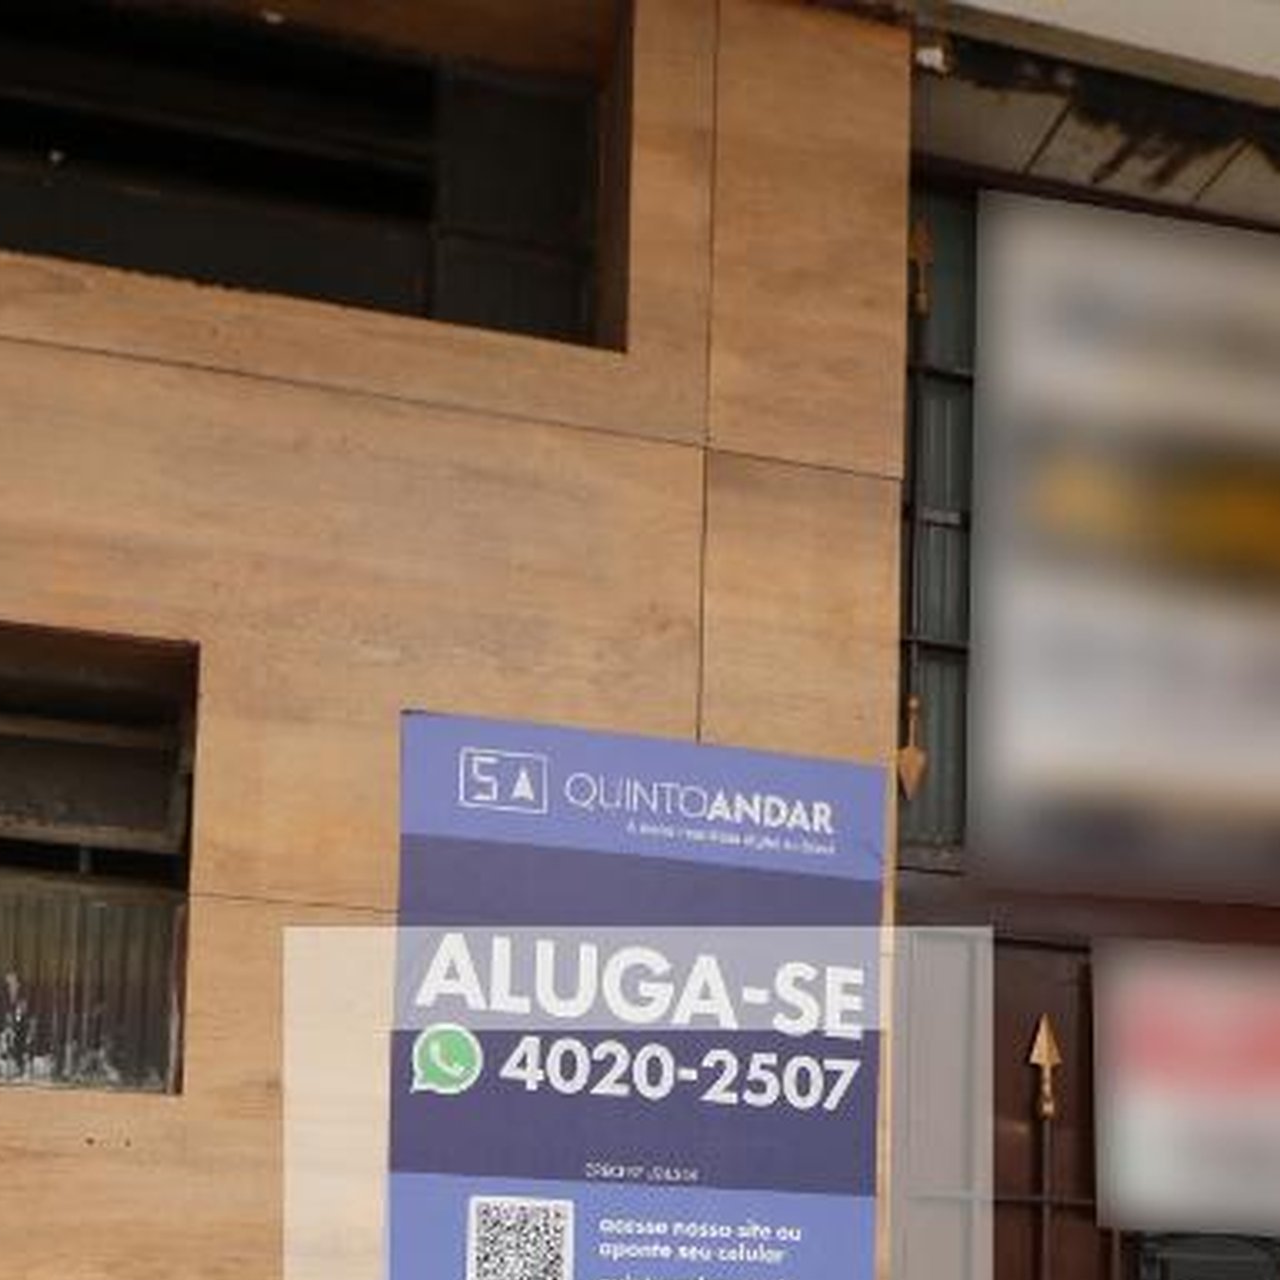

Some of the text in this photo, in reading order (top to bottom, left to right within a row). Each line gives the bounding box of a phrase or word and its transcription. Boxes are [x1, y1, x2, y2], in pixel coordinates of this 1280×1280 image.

[564, 772, 835, 834] QUINTOANDAR
[416, 932, 865, 1041] ALUGA-SE
[499, 1034, 862, 1112] 4020-2507
[598, 1241, 786, 1264] aponte seu celular
[672, 1221, 732, 1239] nosso
[775, 1226, 802, 1242] ou
